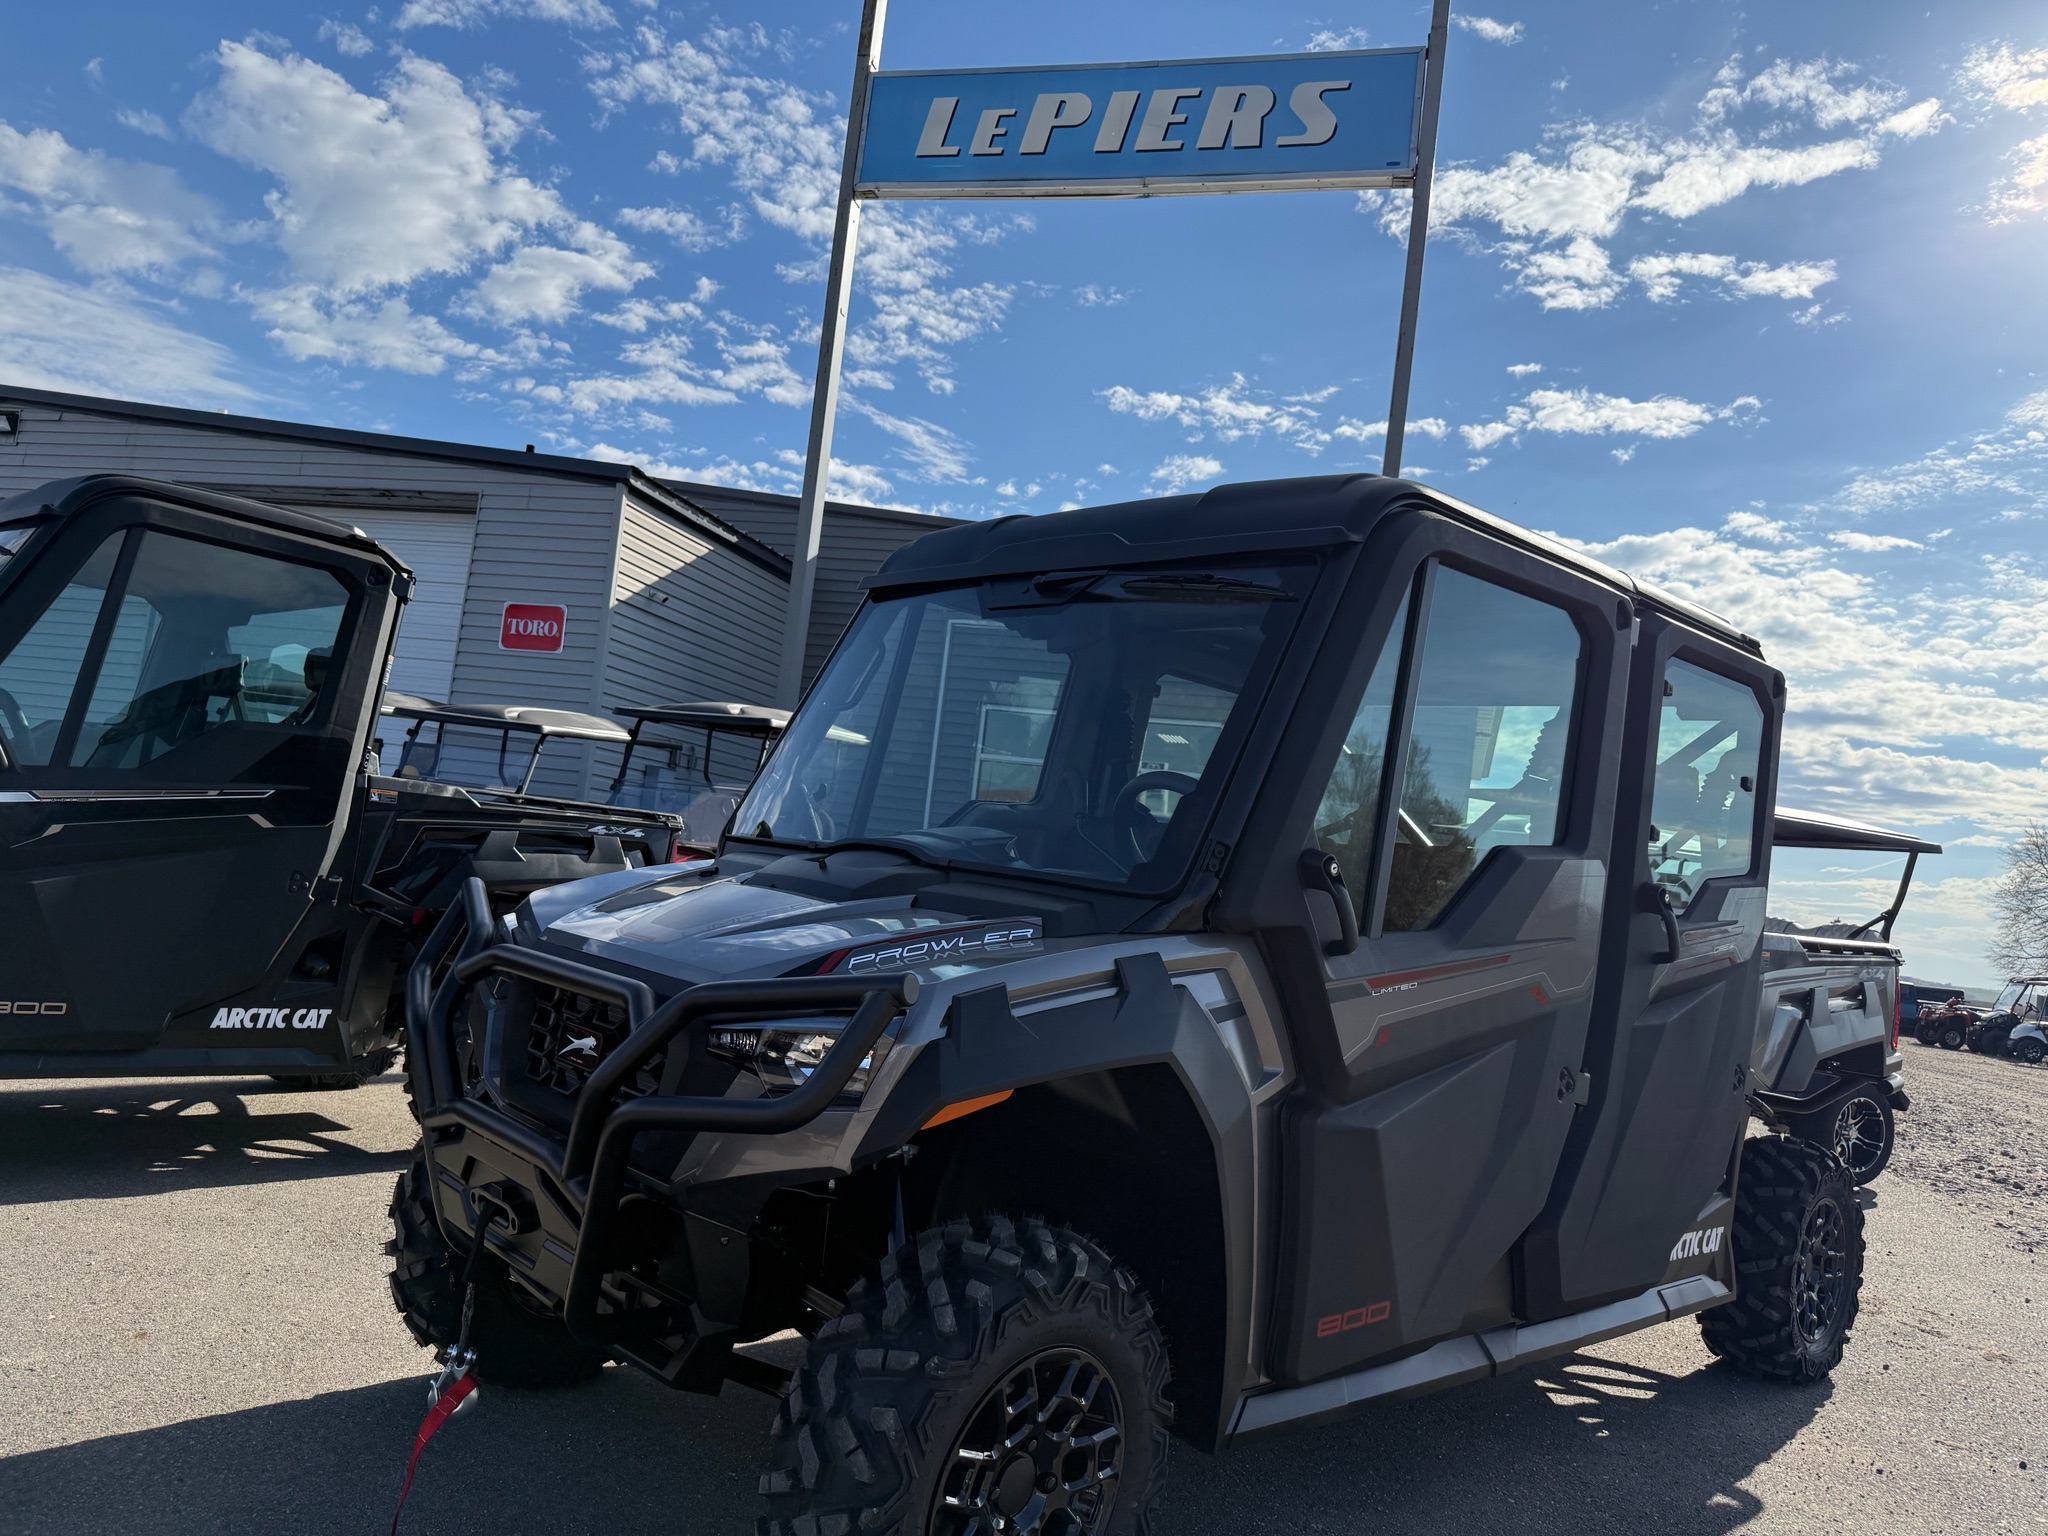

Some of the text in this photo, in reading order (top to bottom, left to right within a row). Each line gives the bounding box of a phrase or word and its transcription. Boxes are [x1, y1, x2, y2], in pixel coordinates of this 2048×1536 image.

[507, 618, 558, 637] TORO
[848, 928, 1034, 969] PROWLER
[1372, 982, 1418, 996] LIMITED
[209, 1007, 333, 1029] ARCTIC CAT
[1702, 1226, 1724, 1254] CAT
[1317, 1301, 1391, 1337] 800
